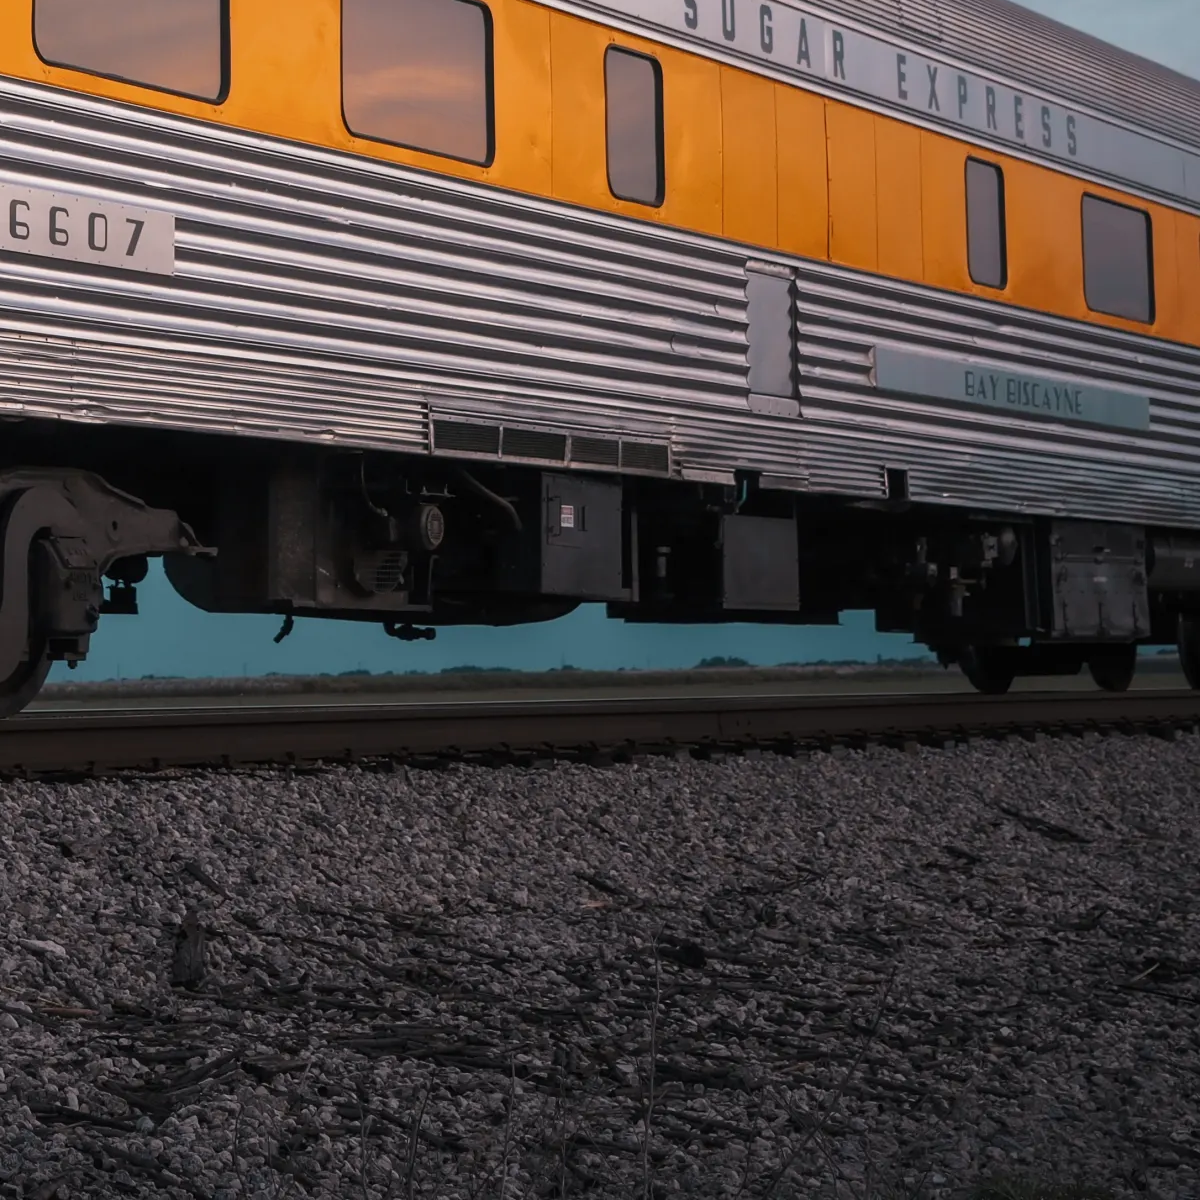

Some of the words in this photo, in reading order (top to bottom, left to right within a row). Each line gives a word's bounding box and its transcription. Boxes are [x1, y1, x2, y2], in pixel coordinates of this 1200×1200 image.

[897, 52, 1077, 156] EXPRESS
[9, 198, 145, 257] 6607
[965, 371, 999, 401] BAY
[1007, 378, 1083, 415] BISCAYNE
